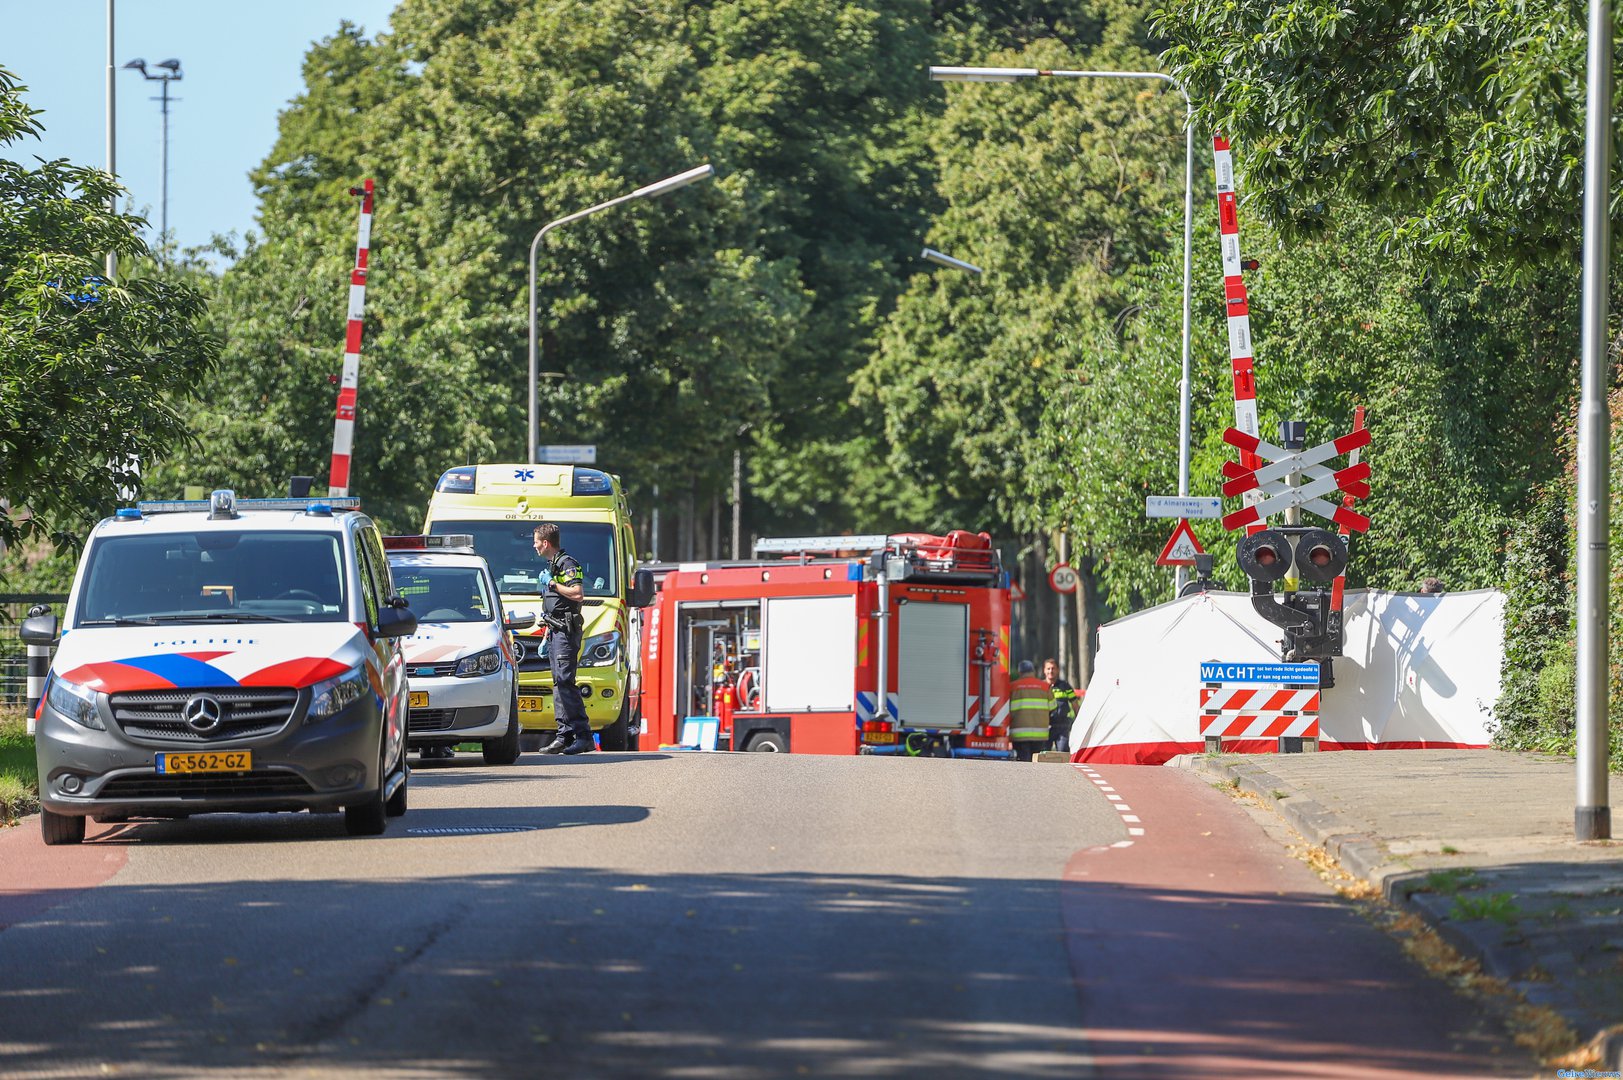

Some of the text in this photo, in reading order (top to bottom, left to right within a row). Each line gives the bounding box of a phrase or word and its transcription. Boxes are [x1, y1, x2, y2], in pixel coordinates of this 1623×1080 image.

[1056, 572, 1075, 585] 30
[153, 638, 260, 647] POLITIE
[1201, 666, 1256, 679] WACHT
[170, 754, 246, 770] G-562-GZ
